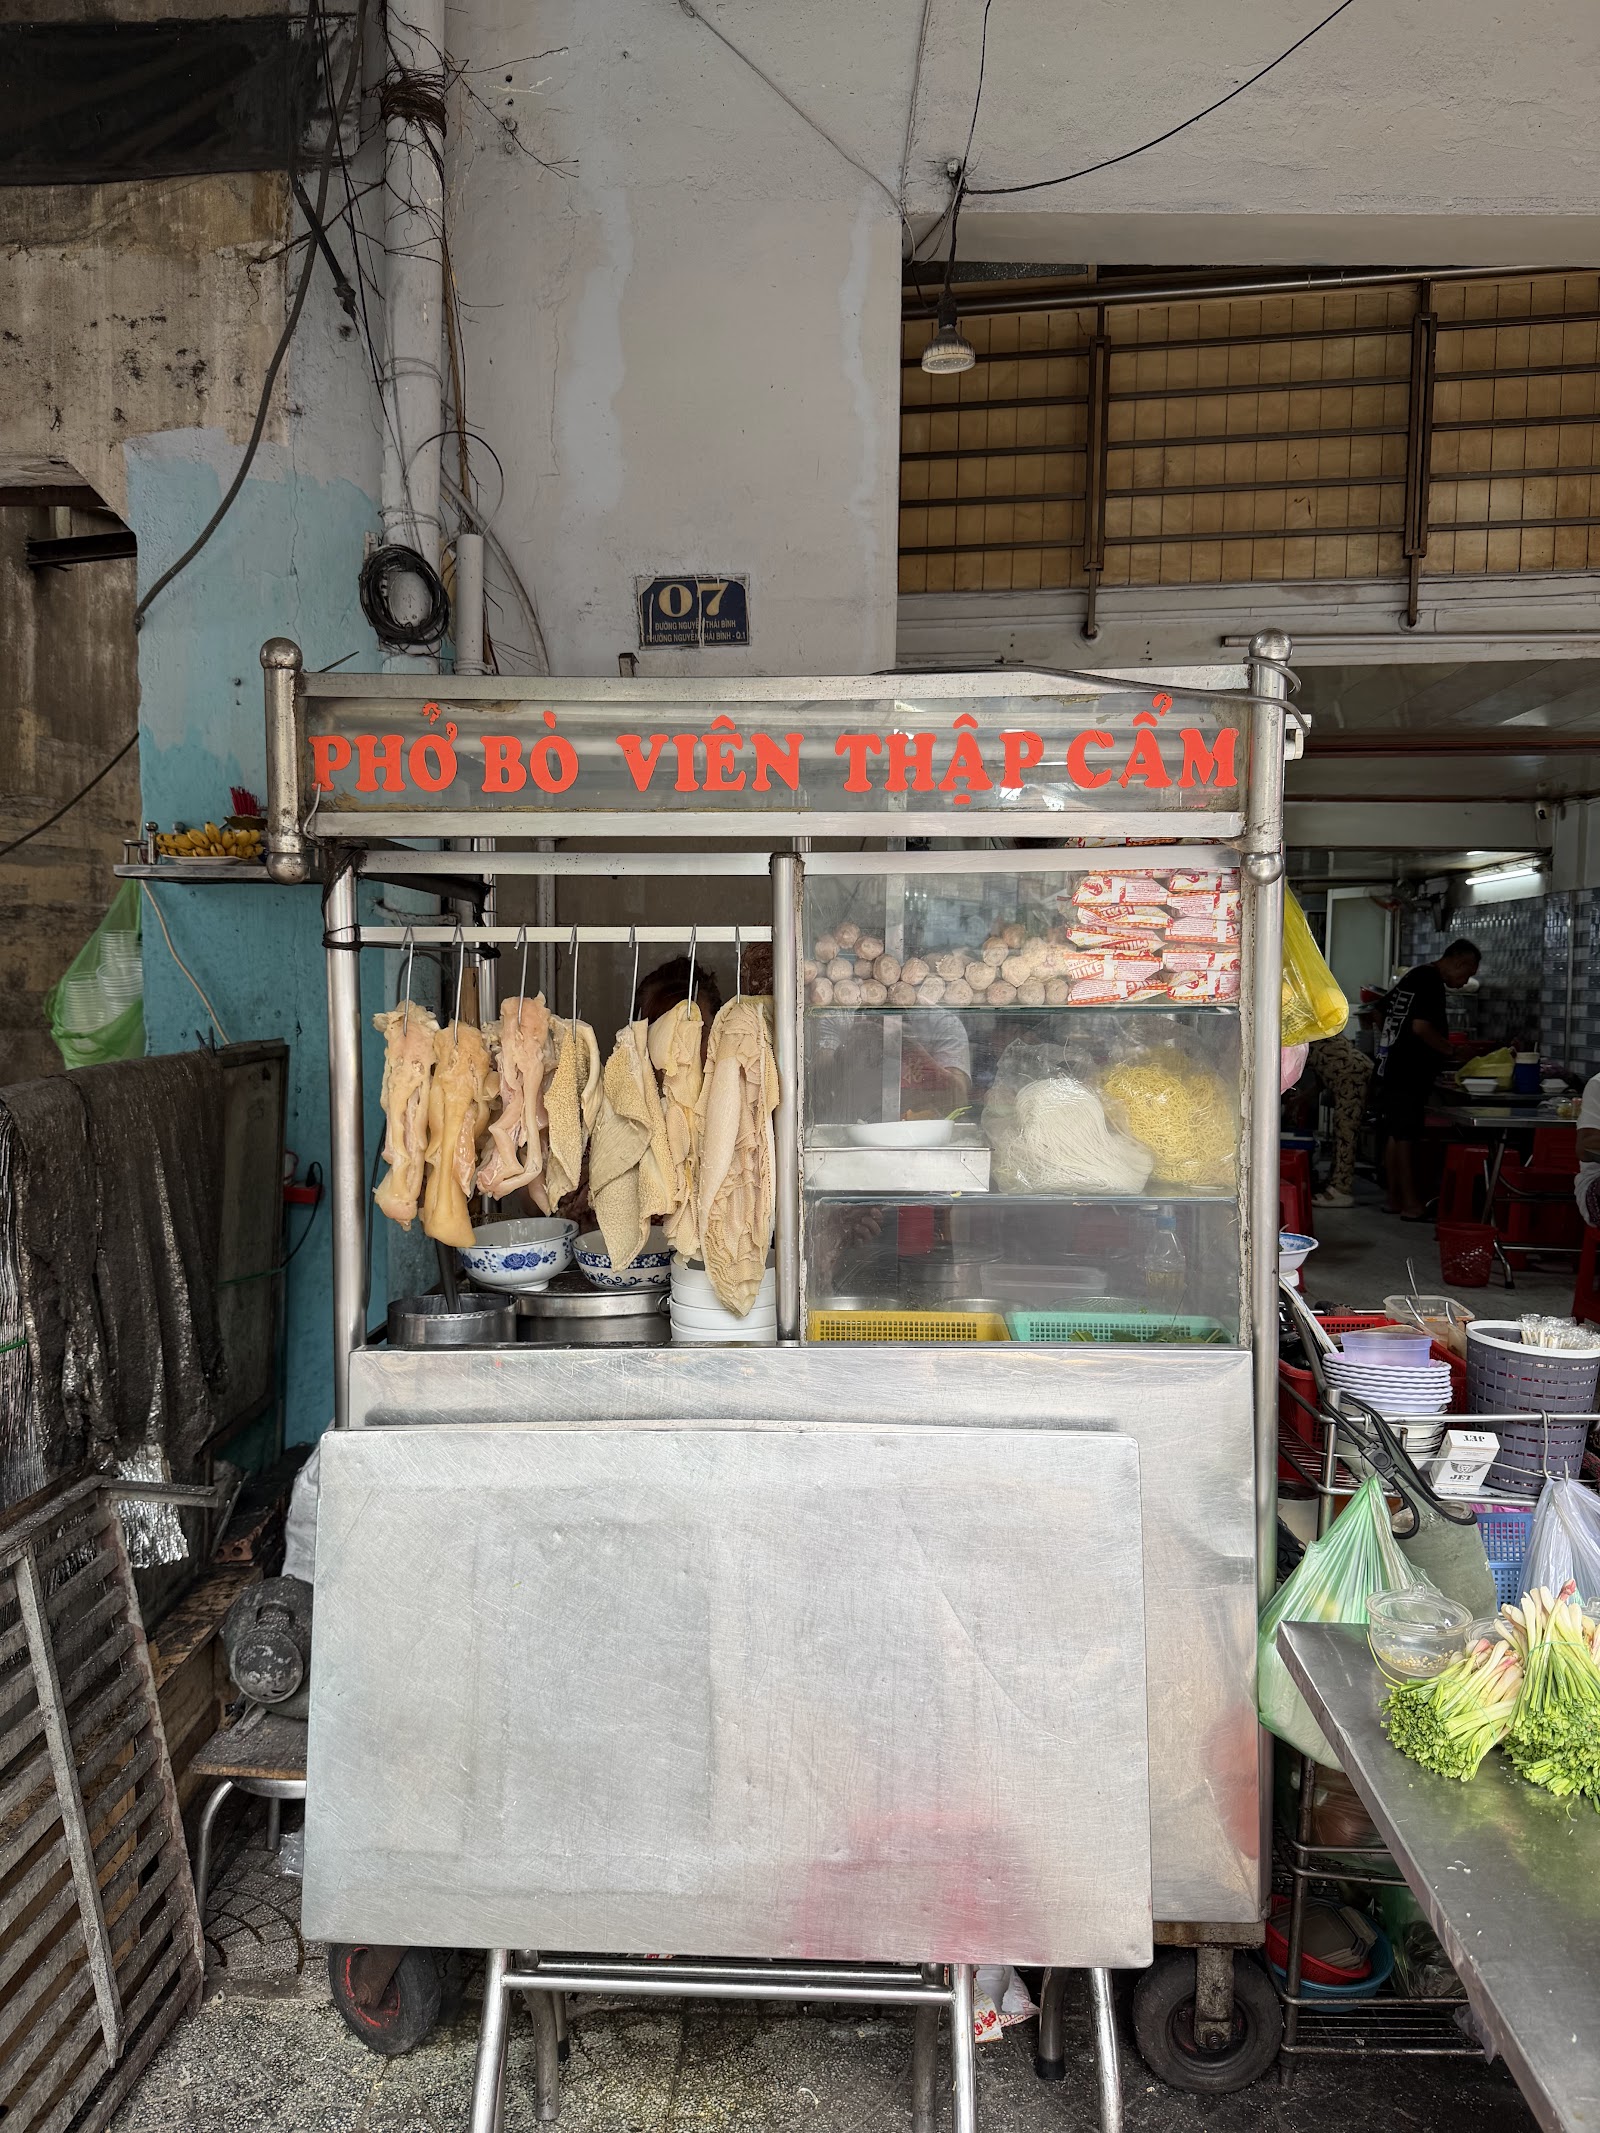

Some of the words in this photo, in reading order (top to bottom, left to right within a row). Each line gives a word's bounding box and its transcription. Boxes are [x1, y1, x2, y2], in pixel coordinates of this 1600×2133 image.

[658, 584, 729, 617] 07
[655, 621, 677, 631] ĐƯỜNG
[678, 618, 704, 630] NGUYỄ
[706, 618, 720, 629] THÁI
[721, 618, 736, 628] BÌNH
[702, 630, 715, 641] HÁI
[716, 630, 731, 640] BÌNH
[308, 702, 457, 791] PHỞ
[480, 711, 579, 793] BÒ
[615, 714, 804, 792] VIÊN
[834, 713, 1045, 805] THẬP
[1066, 693, 1239, 789] CẨM
